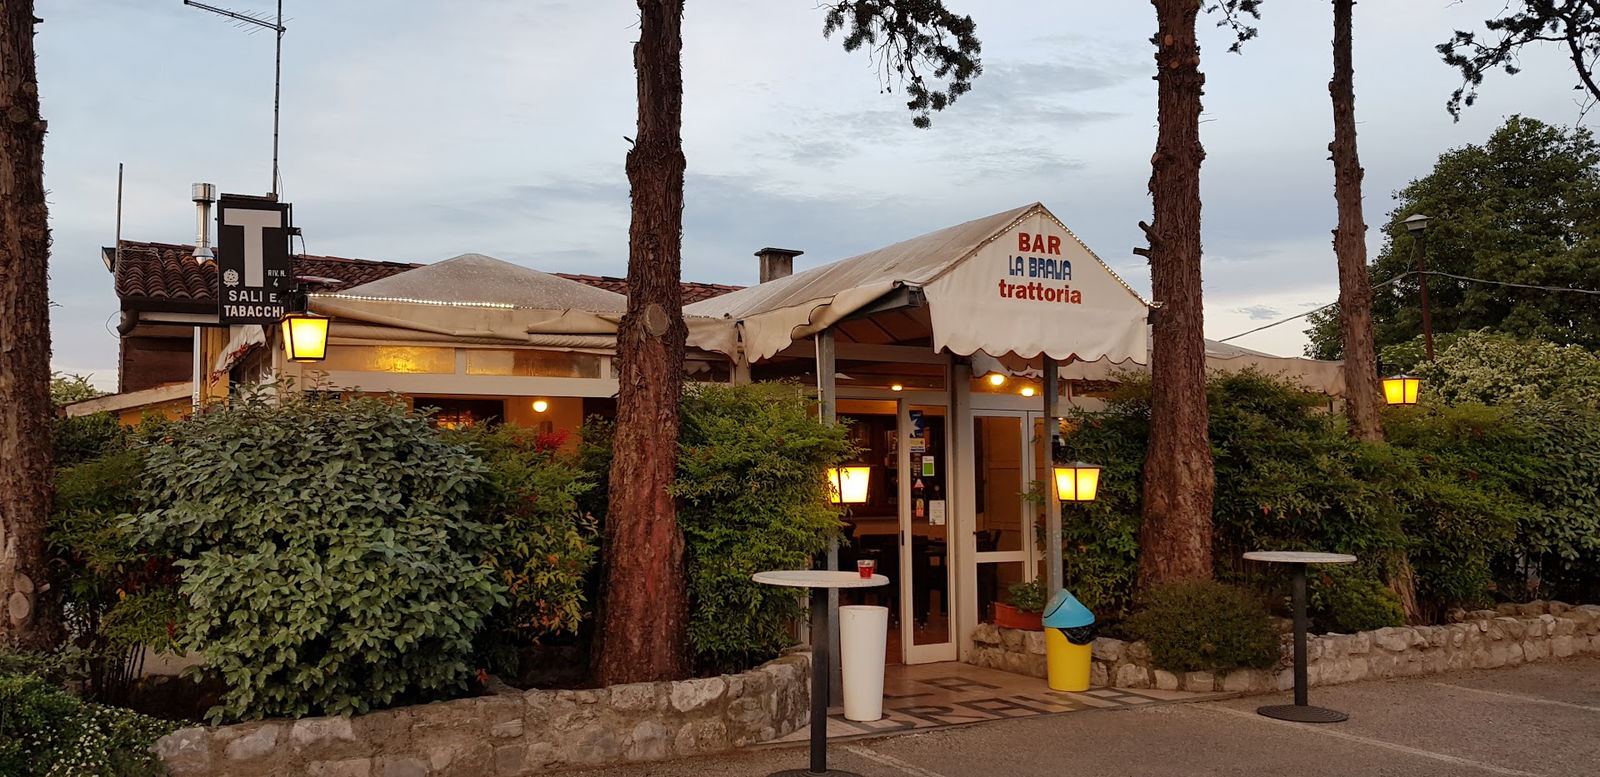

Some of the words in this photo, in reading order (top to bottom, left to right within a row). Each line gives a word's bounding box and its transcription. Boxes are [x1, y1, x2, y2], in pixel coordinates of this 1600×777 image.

[223, 208, 281, 287] T
[1019, 232, 1061, 255] BAR
[1009, 255, 1024, 276] LA
[1028, 257, 1071, 280] BRAVA
[273, 278, 279, 287] 4
[998, 279, 1082, 304] trattoria
[228, 290, 262, 302] SALI
[223, 305, 285, 318] TABACCHI
